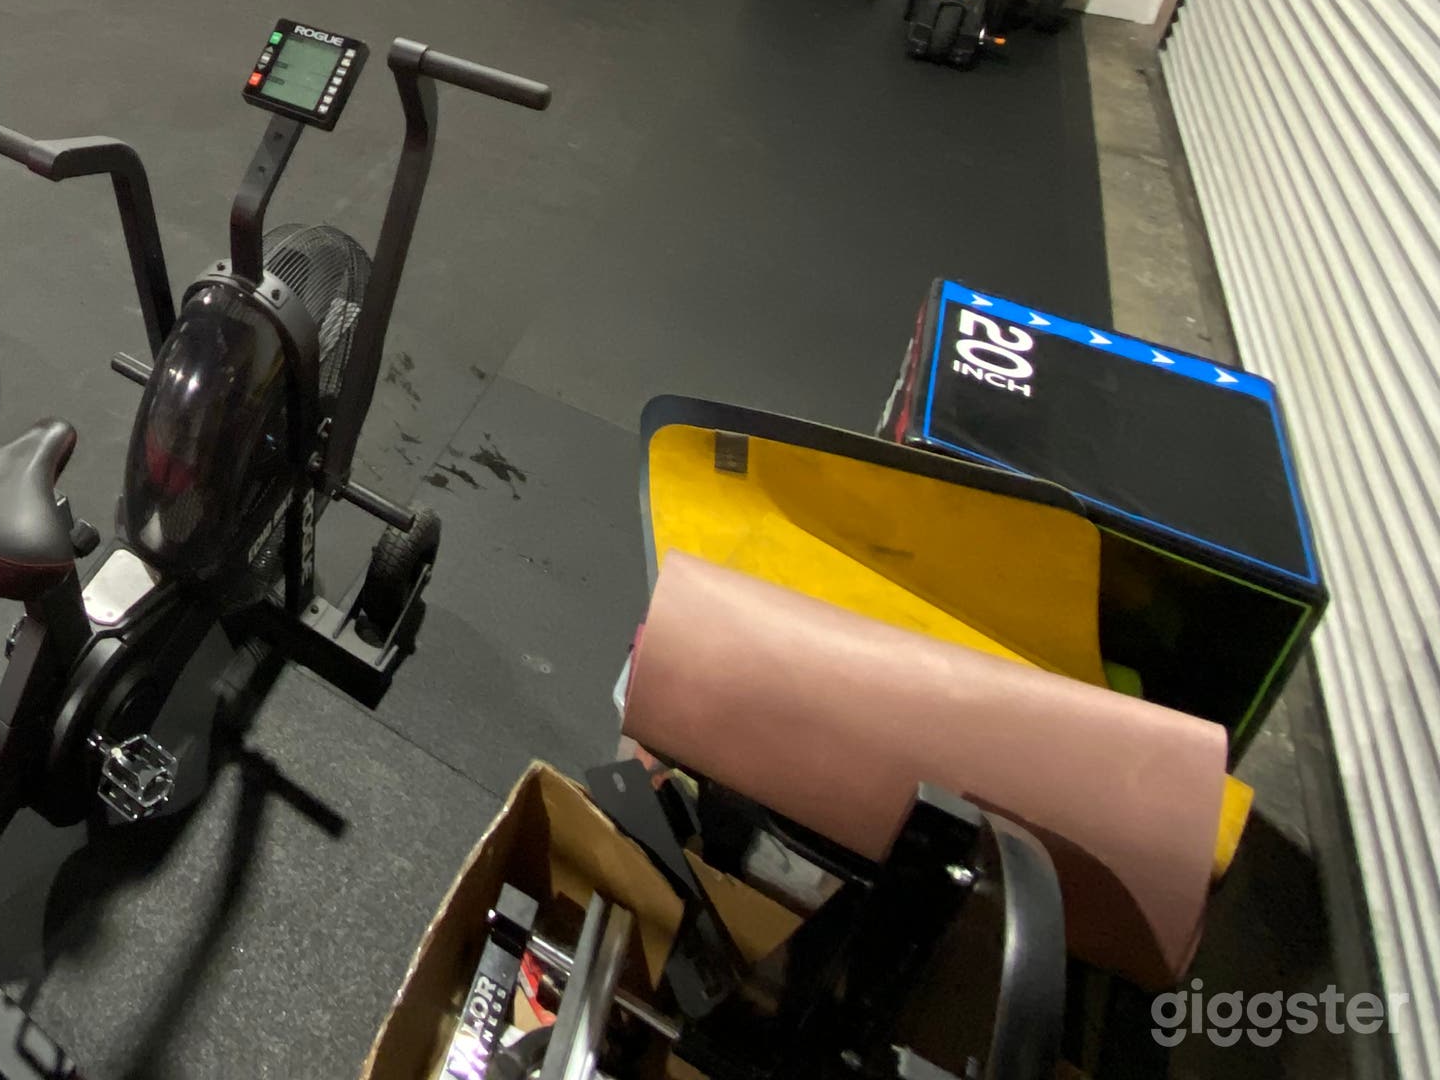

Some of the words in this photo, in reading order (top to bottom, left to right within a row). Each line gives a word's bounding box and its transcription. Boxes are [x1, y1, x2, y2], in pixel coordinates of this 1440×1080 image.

[294, 24, 345, 48] ROGUE
[956, 308, 1034, 379] 20
[953, 359, 1032, 397] INCH
